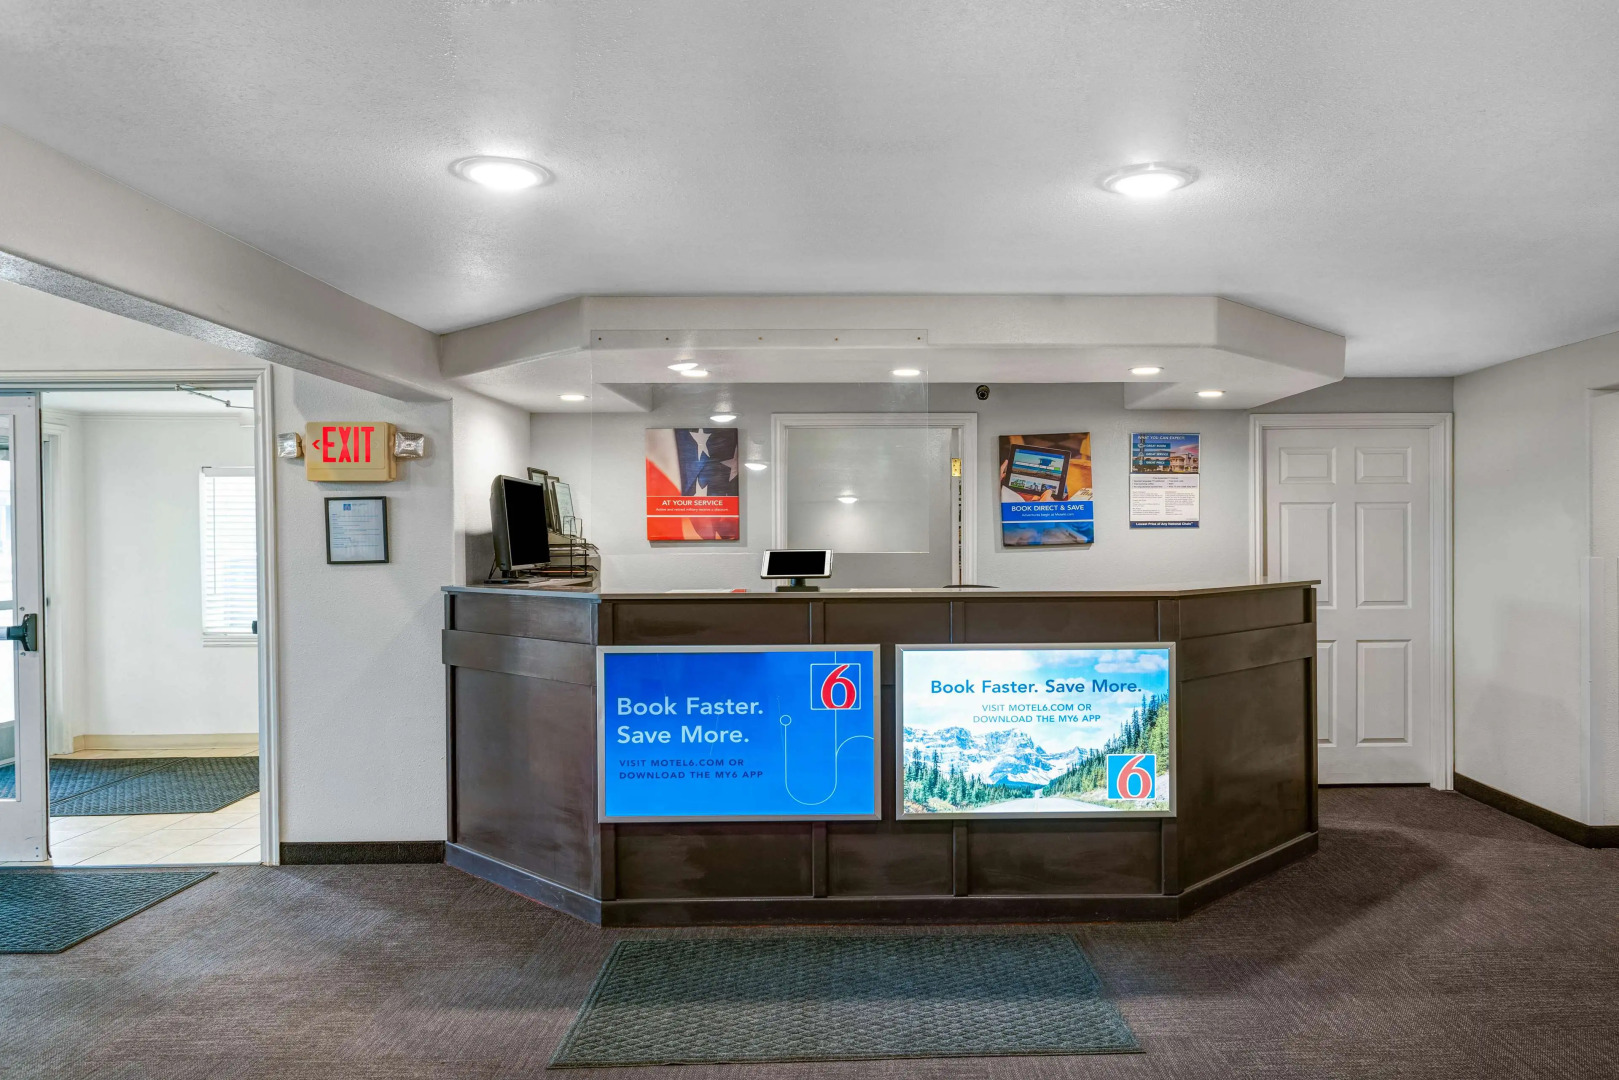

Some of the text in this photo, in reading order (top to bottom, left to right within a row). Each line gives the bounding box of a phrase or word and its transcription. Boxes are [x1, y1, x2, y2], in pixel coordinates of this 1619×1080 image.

[322, 426, 375, 462] EXIT
[820, 663, 857, 710] 6
[931, 679, 1142, 694] Book Faster. Save More.
[617, 696, 764, 716] Book Faster.
[982, 703, 1092, 712] VISIT MOTEL6.COM OR
[973, 715, 1033, 723] DOWNLOAD
[617, 725, 749, 744] Save More.
[619, 758, 744, 767] VISIT MOTEL6.COM OR
[619, 770, 763, 780] DOWNLOAD THE MY6 APP
[1117, 755, 1153, 799] 6
